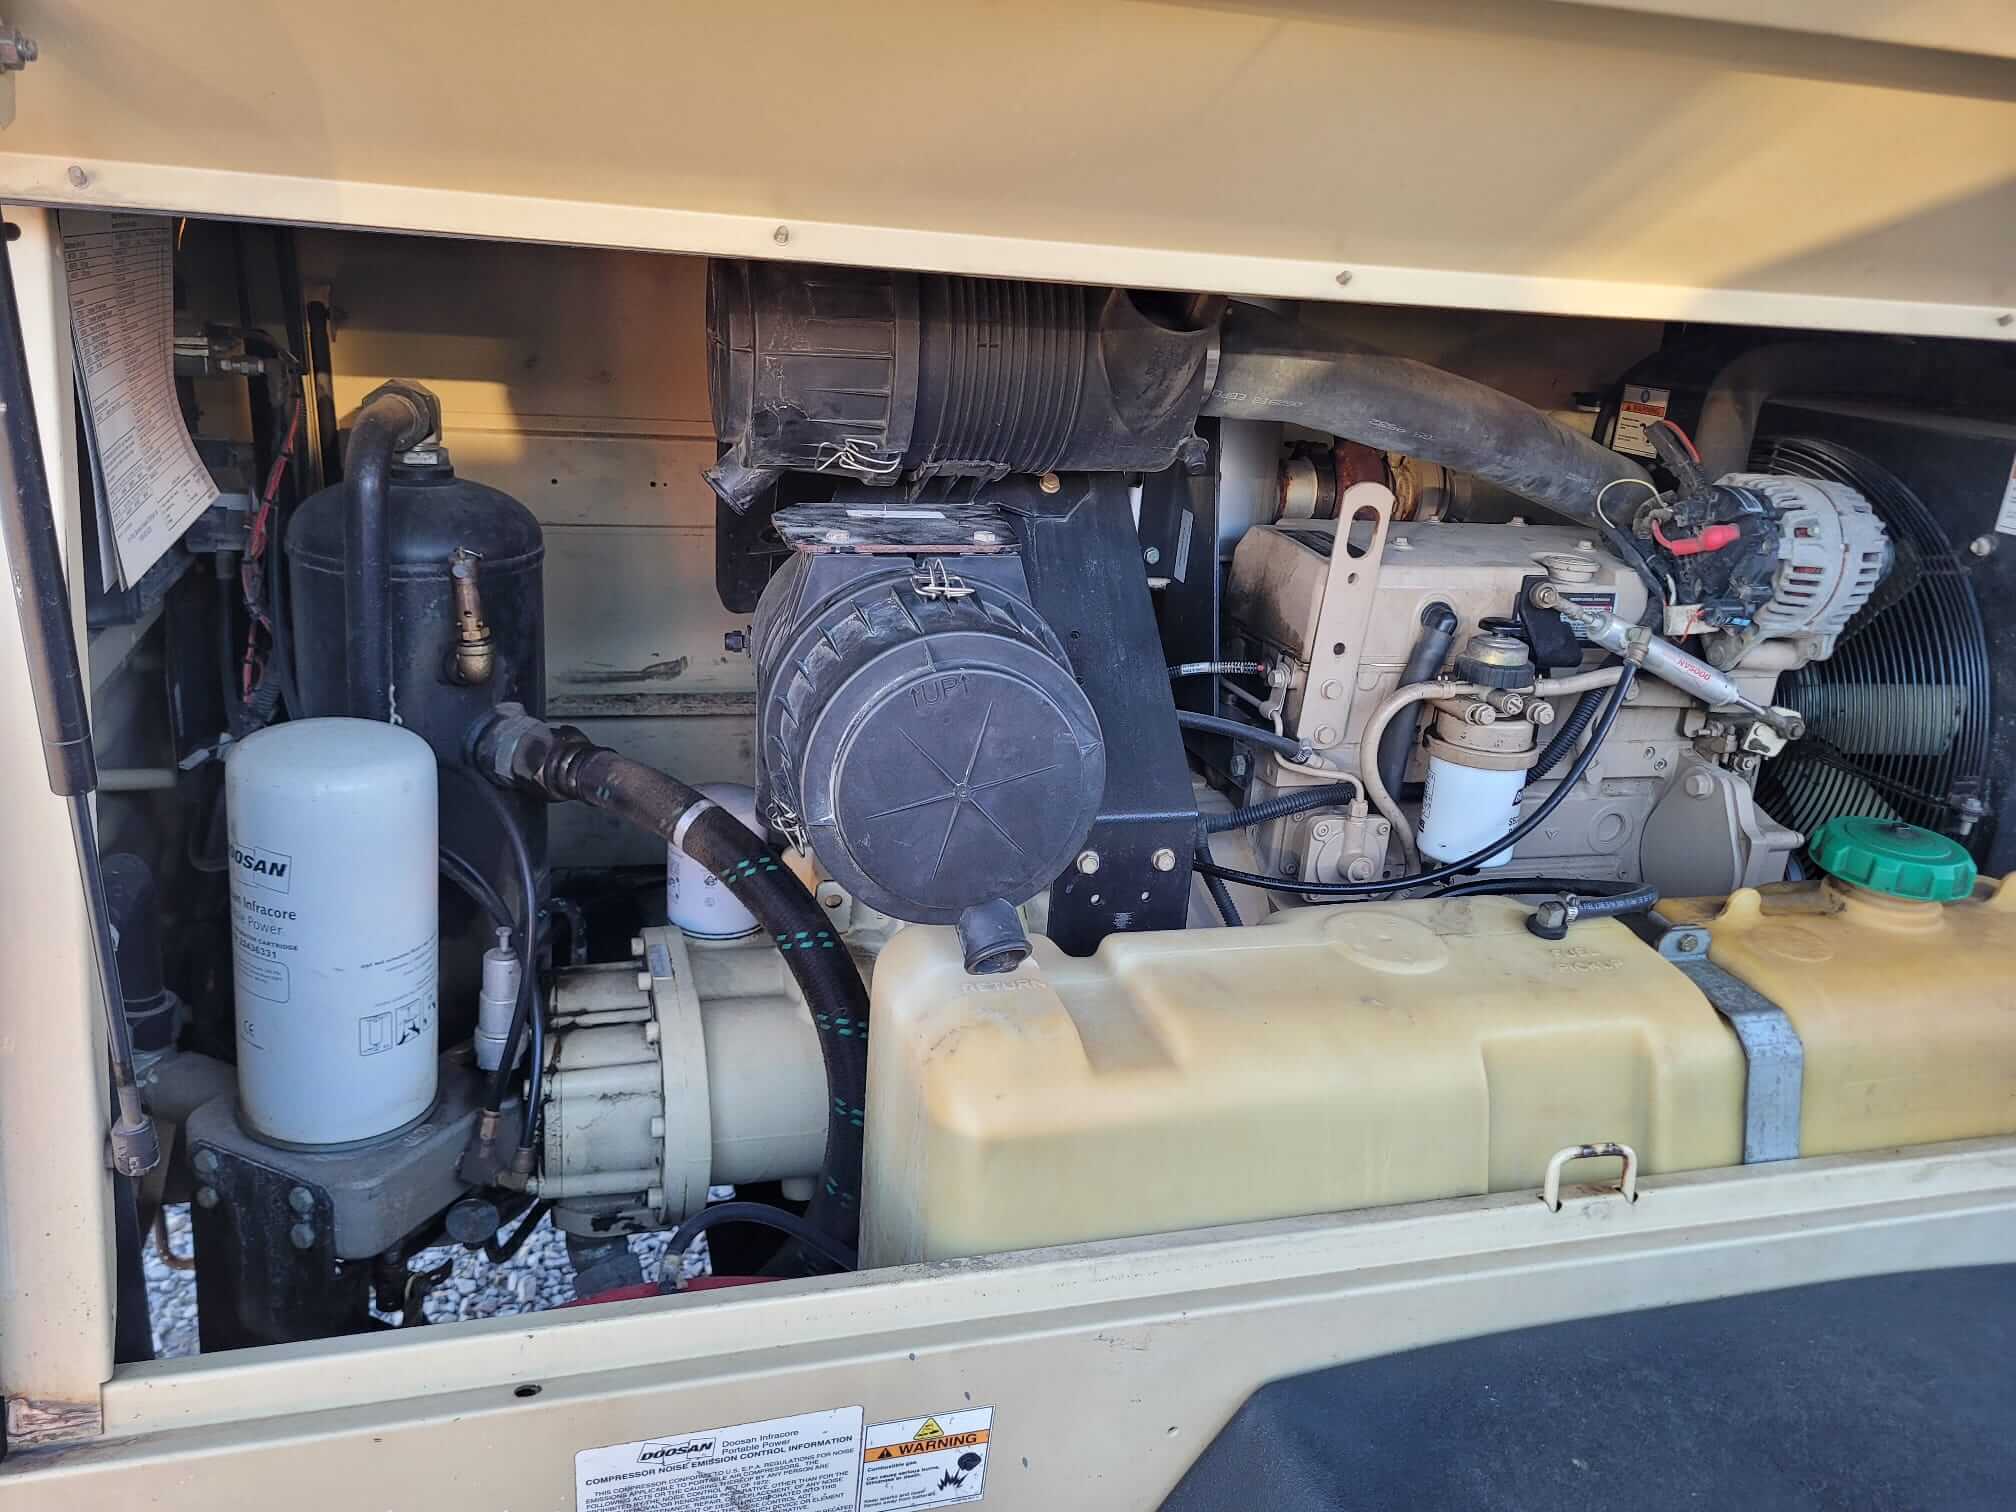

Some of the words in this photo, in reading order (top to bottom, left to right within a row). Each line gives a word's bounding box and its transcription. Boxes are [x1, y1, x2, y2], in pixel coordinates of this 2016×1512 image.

[921, 678, 958, 706] UP
[243, 896, 297, 920] Infracore
[722, 1437, 758, 1448] Doosan
[760, 1430, 799, 1441] Infracore
[722, 1444, 760, 1456] Portable
[762, 1439, 791, 1449] Power
[899, 1433, 977, 1455] WARNING
[585, 1468, 655, 1486] COMPRESSOR
[658, 1462, 688, 1473] NOISE
[691, 1453, 738, 1467] EMISSION
[739, 1445, 786, 1459] CONTROL
[788, 1433, 852, 1450] INFORMATION
[640, 1442, 713, 1461] DOOSAN
[594, 1489, 611, 1497] THIS
